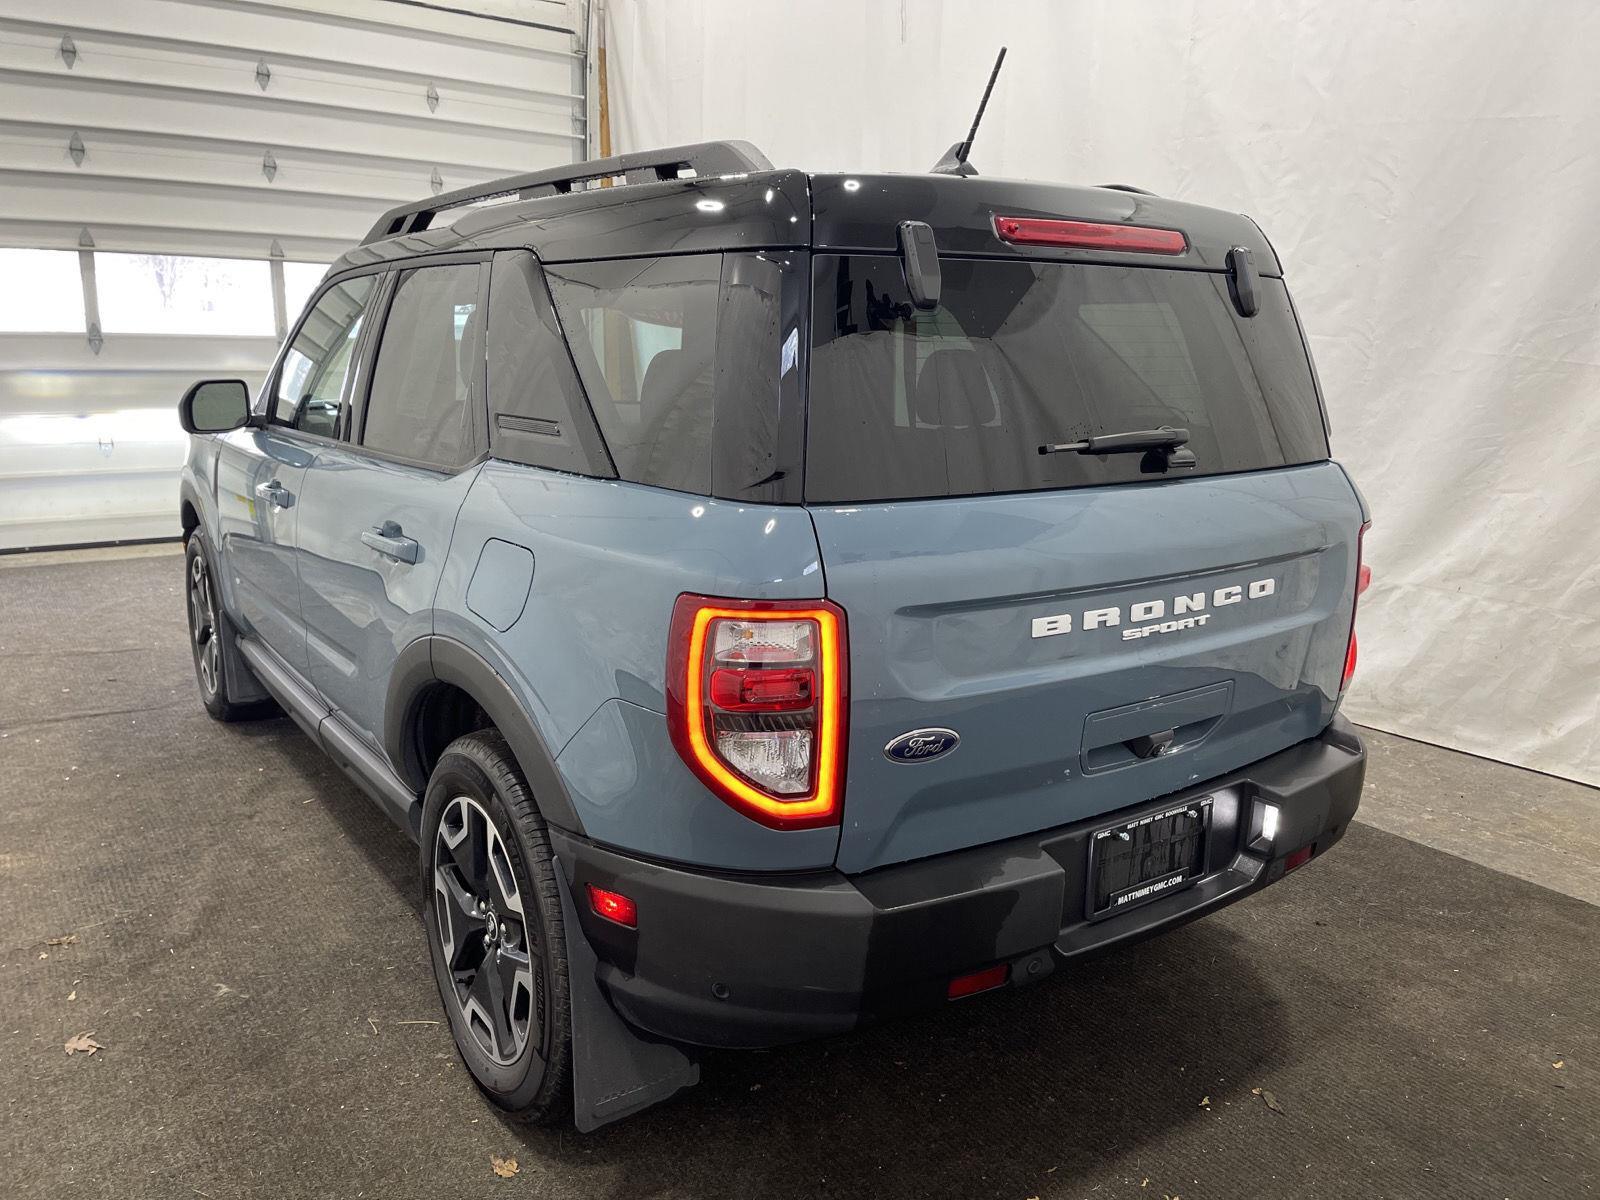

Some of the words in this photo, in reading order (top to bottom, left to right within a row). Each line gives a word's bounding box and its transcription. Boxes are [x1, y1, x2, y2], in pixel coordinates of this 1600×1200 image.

[1031, 578, 1275, 638] BRONCO
[1121, 614, 1211, 641] SPORT
[903, 735, 945, 758] Ford
[1200, 798, 1213, 807] GMC
[1127, 821, 1139, 830] MATT
[1154, 813, 1165, 821] GMC
[1097, 830, 1111, 840] GMC
[1117, 875, 1183, 905] MATTNIMEYGMC.COM
